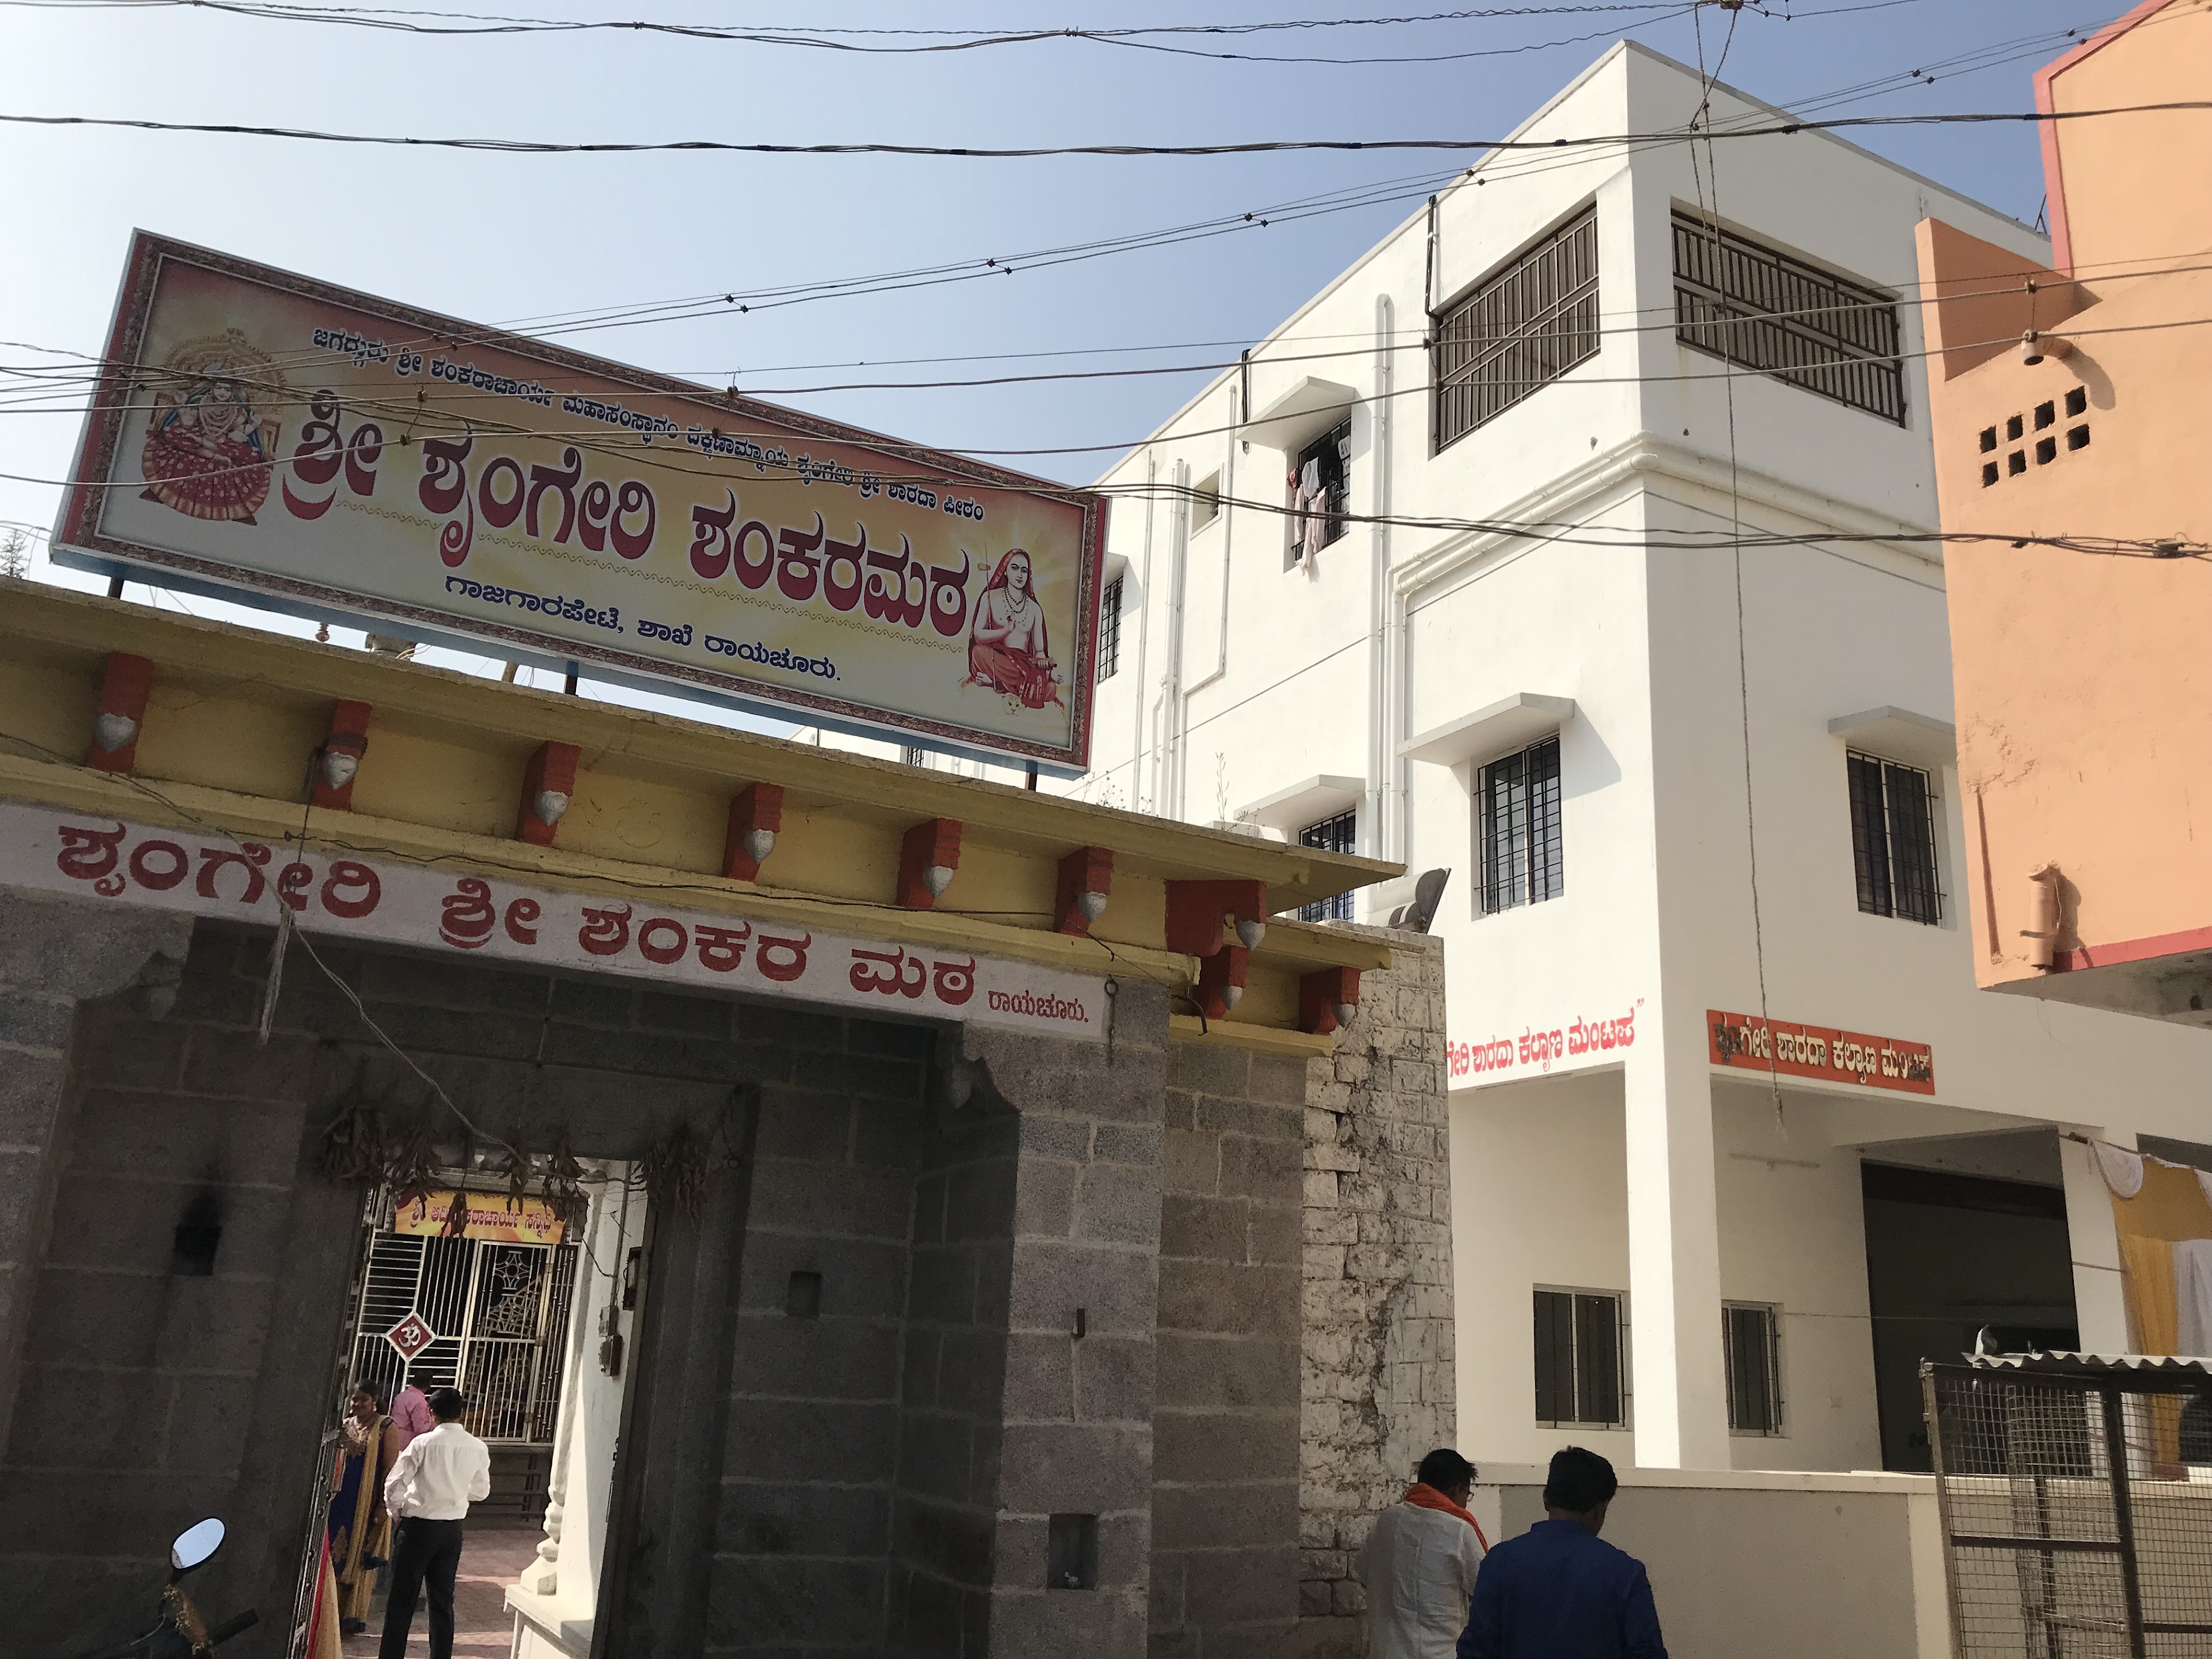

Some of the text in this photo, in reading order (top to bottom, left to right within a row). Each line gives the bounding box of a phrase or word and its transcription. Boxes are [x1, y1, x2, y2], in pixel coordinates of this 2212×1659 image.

[313, 329, 388, 368] ಜಗದ್ಗುರು
[396, 347, 422, 376] ಶ್ರೀ
[431, 358, 555, 406] ಶಂಕರಾಚಾರ್ಯ
[563, 393, 679, 444] ಮಹಾಸಂಸ್ಥಾನಂ
[888, 481, 937, 509] ಶಾರದಾ
[944, 495, 984, 521] ಪೀಠಂ
[282, 389, 969, 637] ಶ್ರೀ ಶೃಂಗೇರಿ ಶಂಕರಮಠ
[445, 576, 842, 681] ಗಾಜಗಾರಪೇಟೆ, ಶಾಖೆ ರಾಯಚೂರು.
[56, 823, 1089, 1022] ಶೃಂಗೇರಿ ಶ್ರೀ ಶಂಕರ ಮಠ ರಾಯಚೂರು.
[1446, 1040, 1469, 1077] ಗೇರಿ
[1472, 1035, 1514, 1073] ಶಾರದಾ
[1518, 1026, 1563, 1072] ಕಲ್ಯಾಣ
[1713, 1013, 1931, 1084] ಶೃಂಗೇರಿ ಶಾರದಾ ಕಲ್ಯಾಣ ಮಂಟಪ
[462, 1206, 521, 1228] ಕರಾಚಾರ್ಯ
